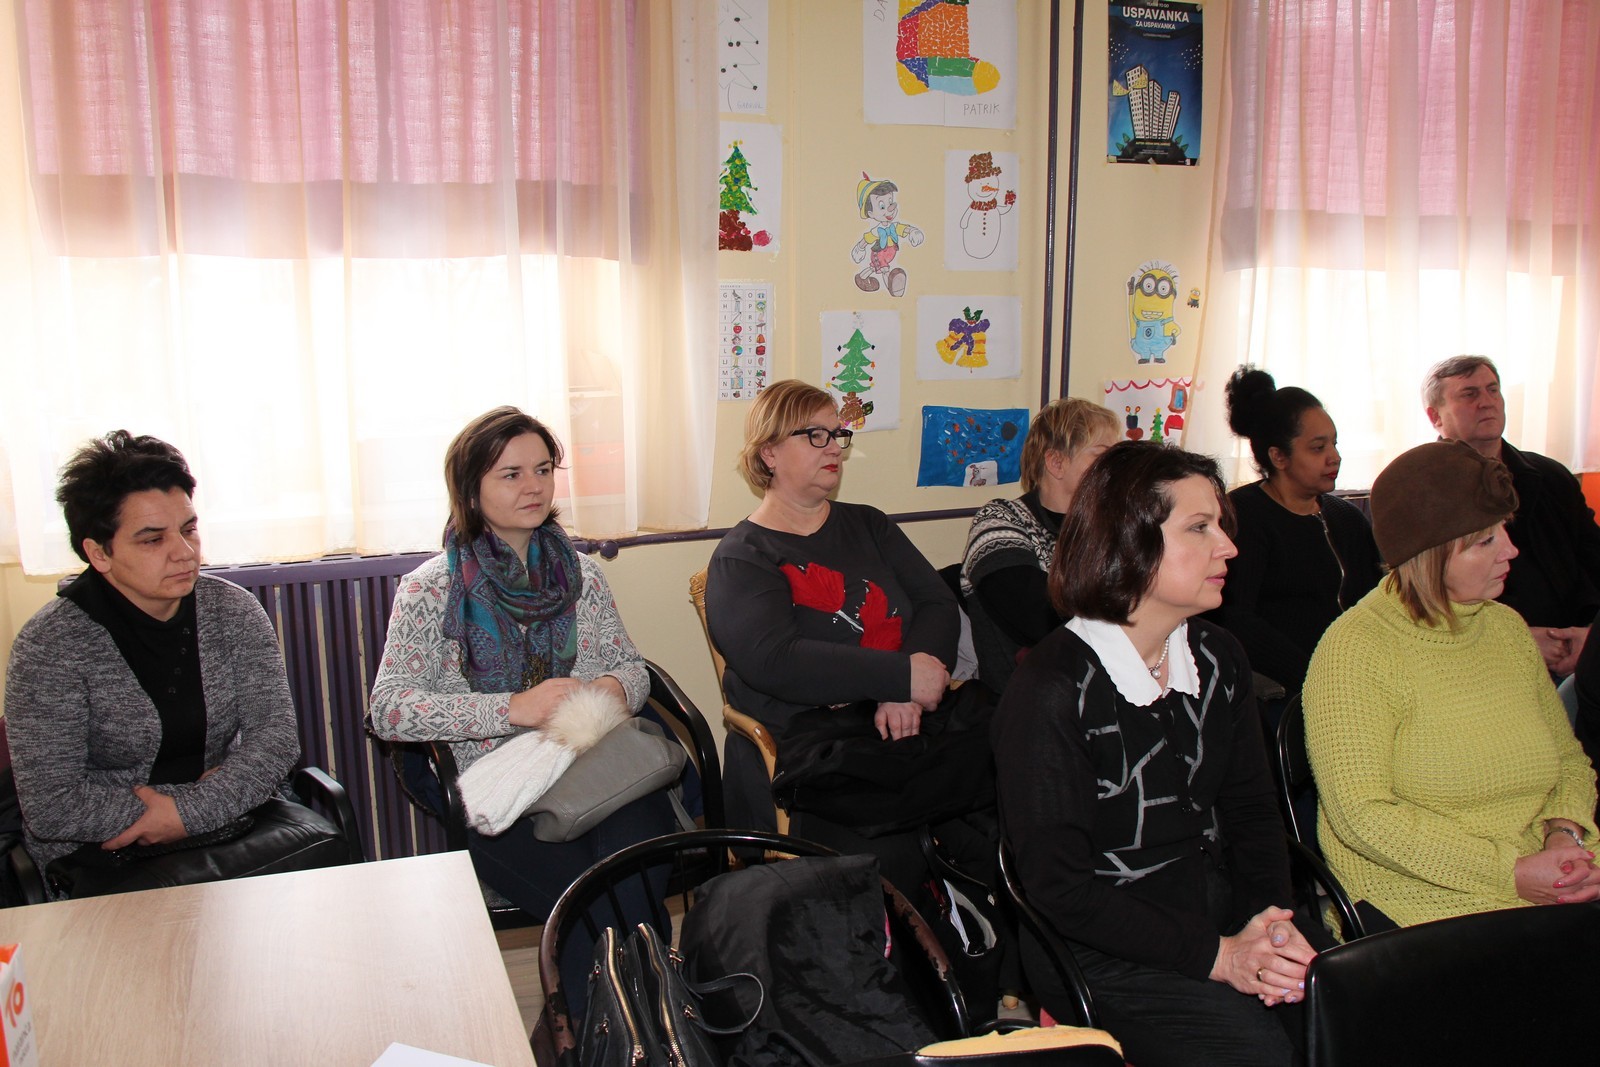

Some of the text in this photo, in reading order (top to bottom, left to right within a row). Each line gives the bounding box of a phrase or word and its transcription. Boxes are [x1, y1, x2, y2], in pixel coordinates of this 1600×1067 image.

[1122, 6, 1190, 23] USPAVANKA
[1143, 21, 1176, 30] USPAVANKA
[963, 103, 1000, 116] PATRIK
